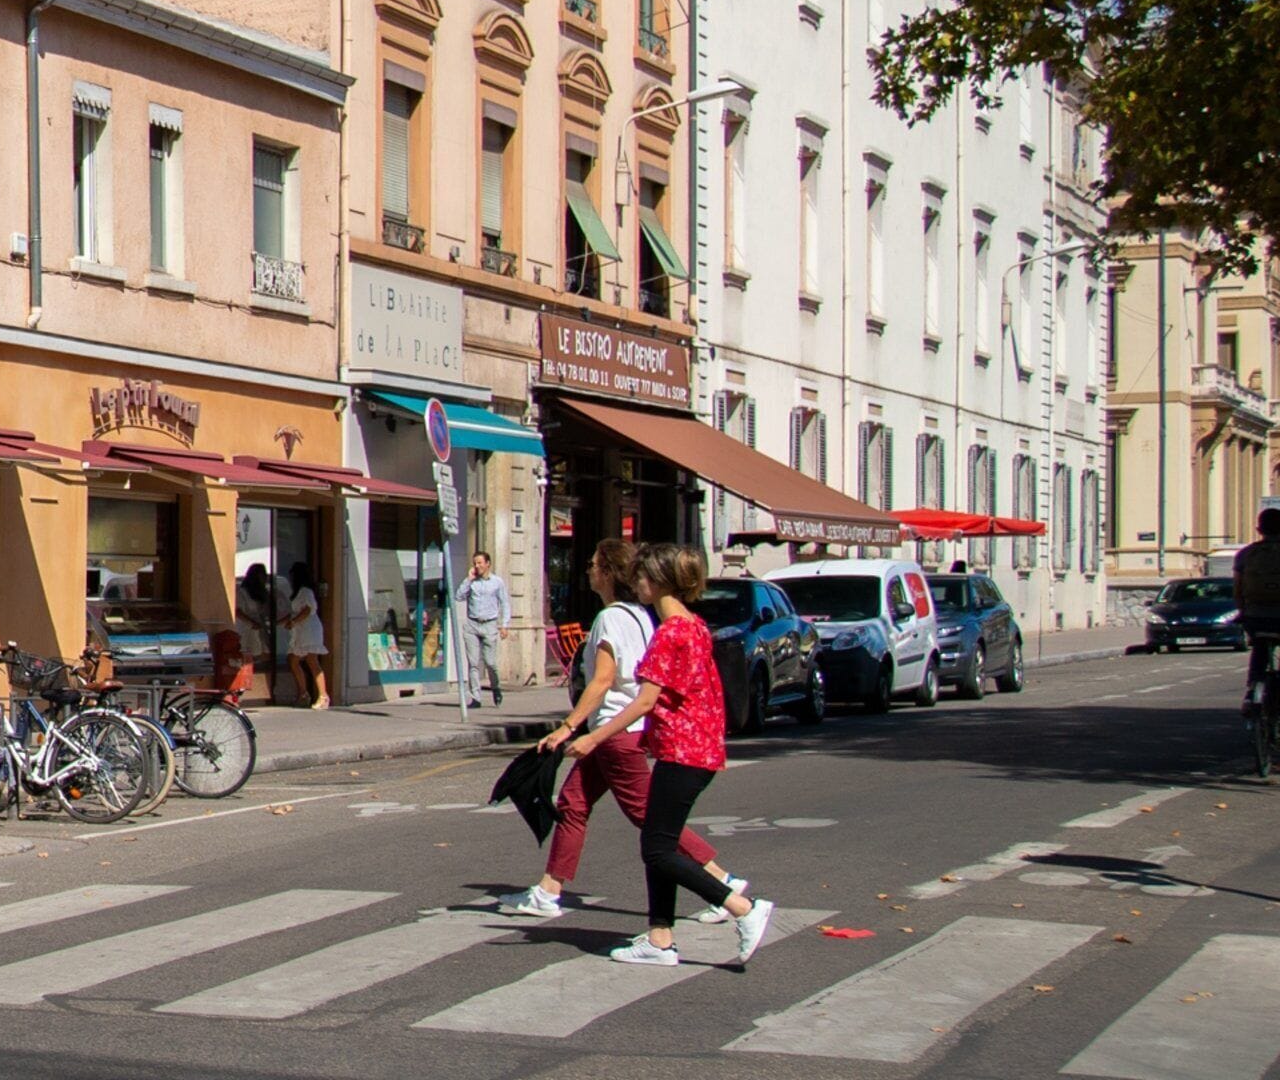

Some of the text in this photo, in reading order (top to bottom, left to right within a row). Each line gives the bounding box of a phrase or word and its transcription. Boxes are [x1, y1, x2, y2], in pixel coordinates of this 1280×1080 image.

[558, 327, 570, 354] LE
[575, 329, 612, 361] BISTRO
[600, 370, 609, 387] 11
